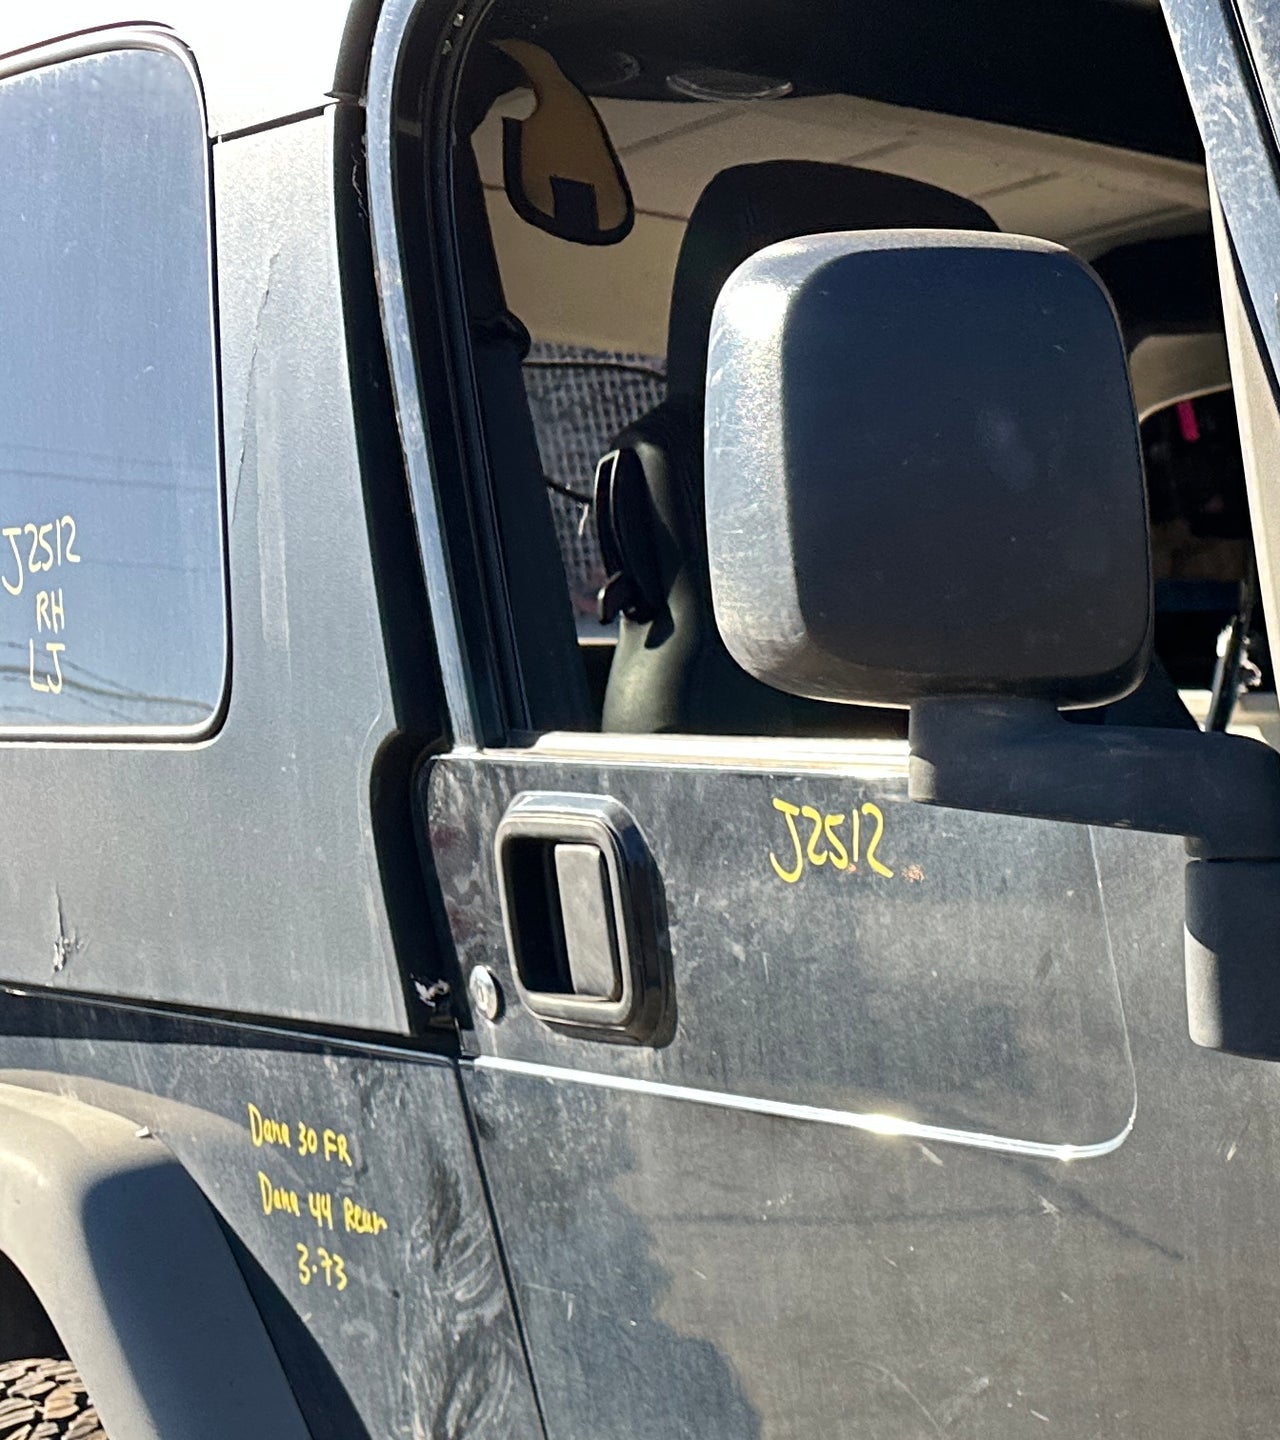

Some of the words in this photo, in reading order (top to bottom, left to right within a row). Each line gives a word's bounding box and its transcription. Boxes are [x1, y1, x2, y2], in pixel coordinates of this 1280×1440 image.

[1, 515, 81, 595] J2512
[36, 588, 65, 634] RH
[29, 639, 65, 694] LJ
[770, 797, 894, 883] J2512
[248, 1102, 291, 1148] Dana
[298, 1121, 318, 1156] 30
[323, 1128, 353, 1167] FR
[257, 1170, 300, 1217] Dana
[308, 1192, 333, 1231] 44
